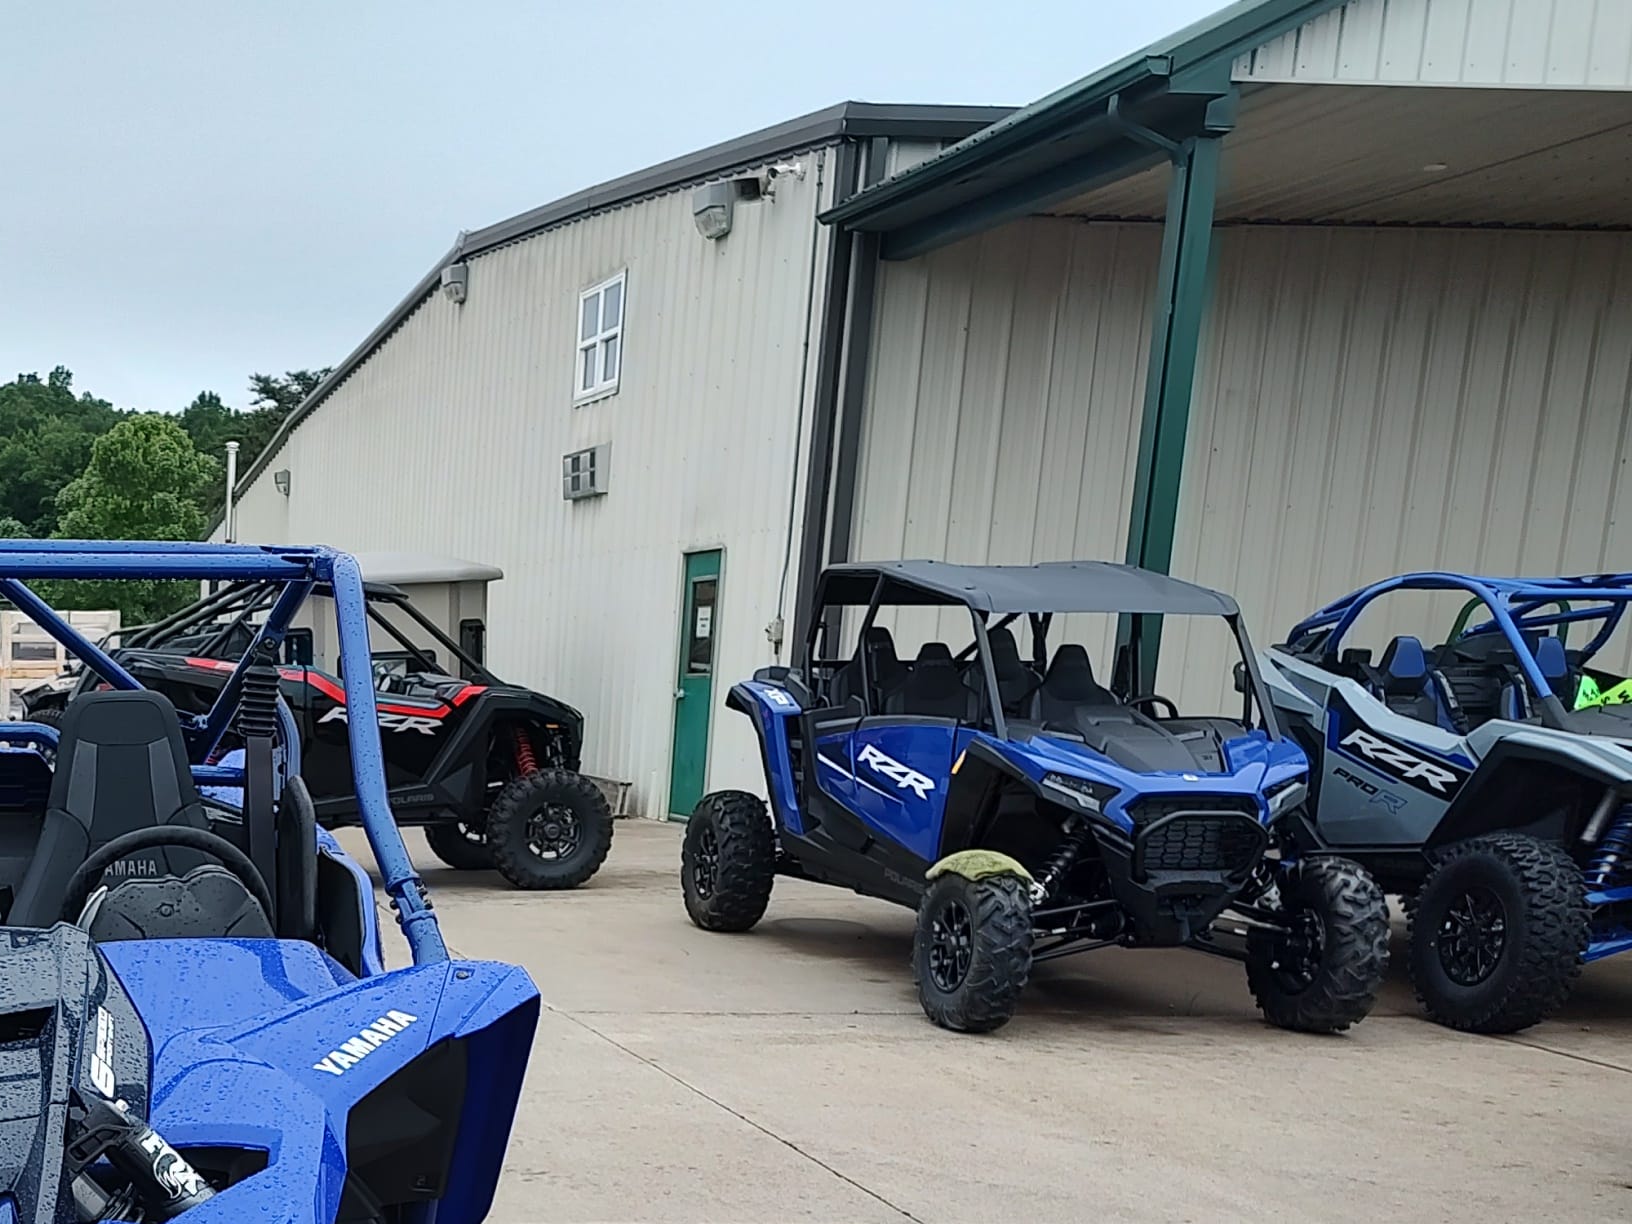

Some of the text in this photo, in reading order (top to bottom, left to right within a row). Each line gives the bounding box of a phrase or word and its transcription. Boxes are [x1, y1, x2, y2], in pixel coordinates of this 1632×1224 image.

[857, 743, 936, 800] RZR
[1340, 728, 1458, 793] RZR
[1332, 767, 1409, 815] PRO R
[104, 860, 157, 876] AMAHA
[312, 1010, 418, 1076] YAMAHA
[90, 1053, 116, 1099] 6
